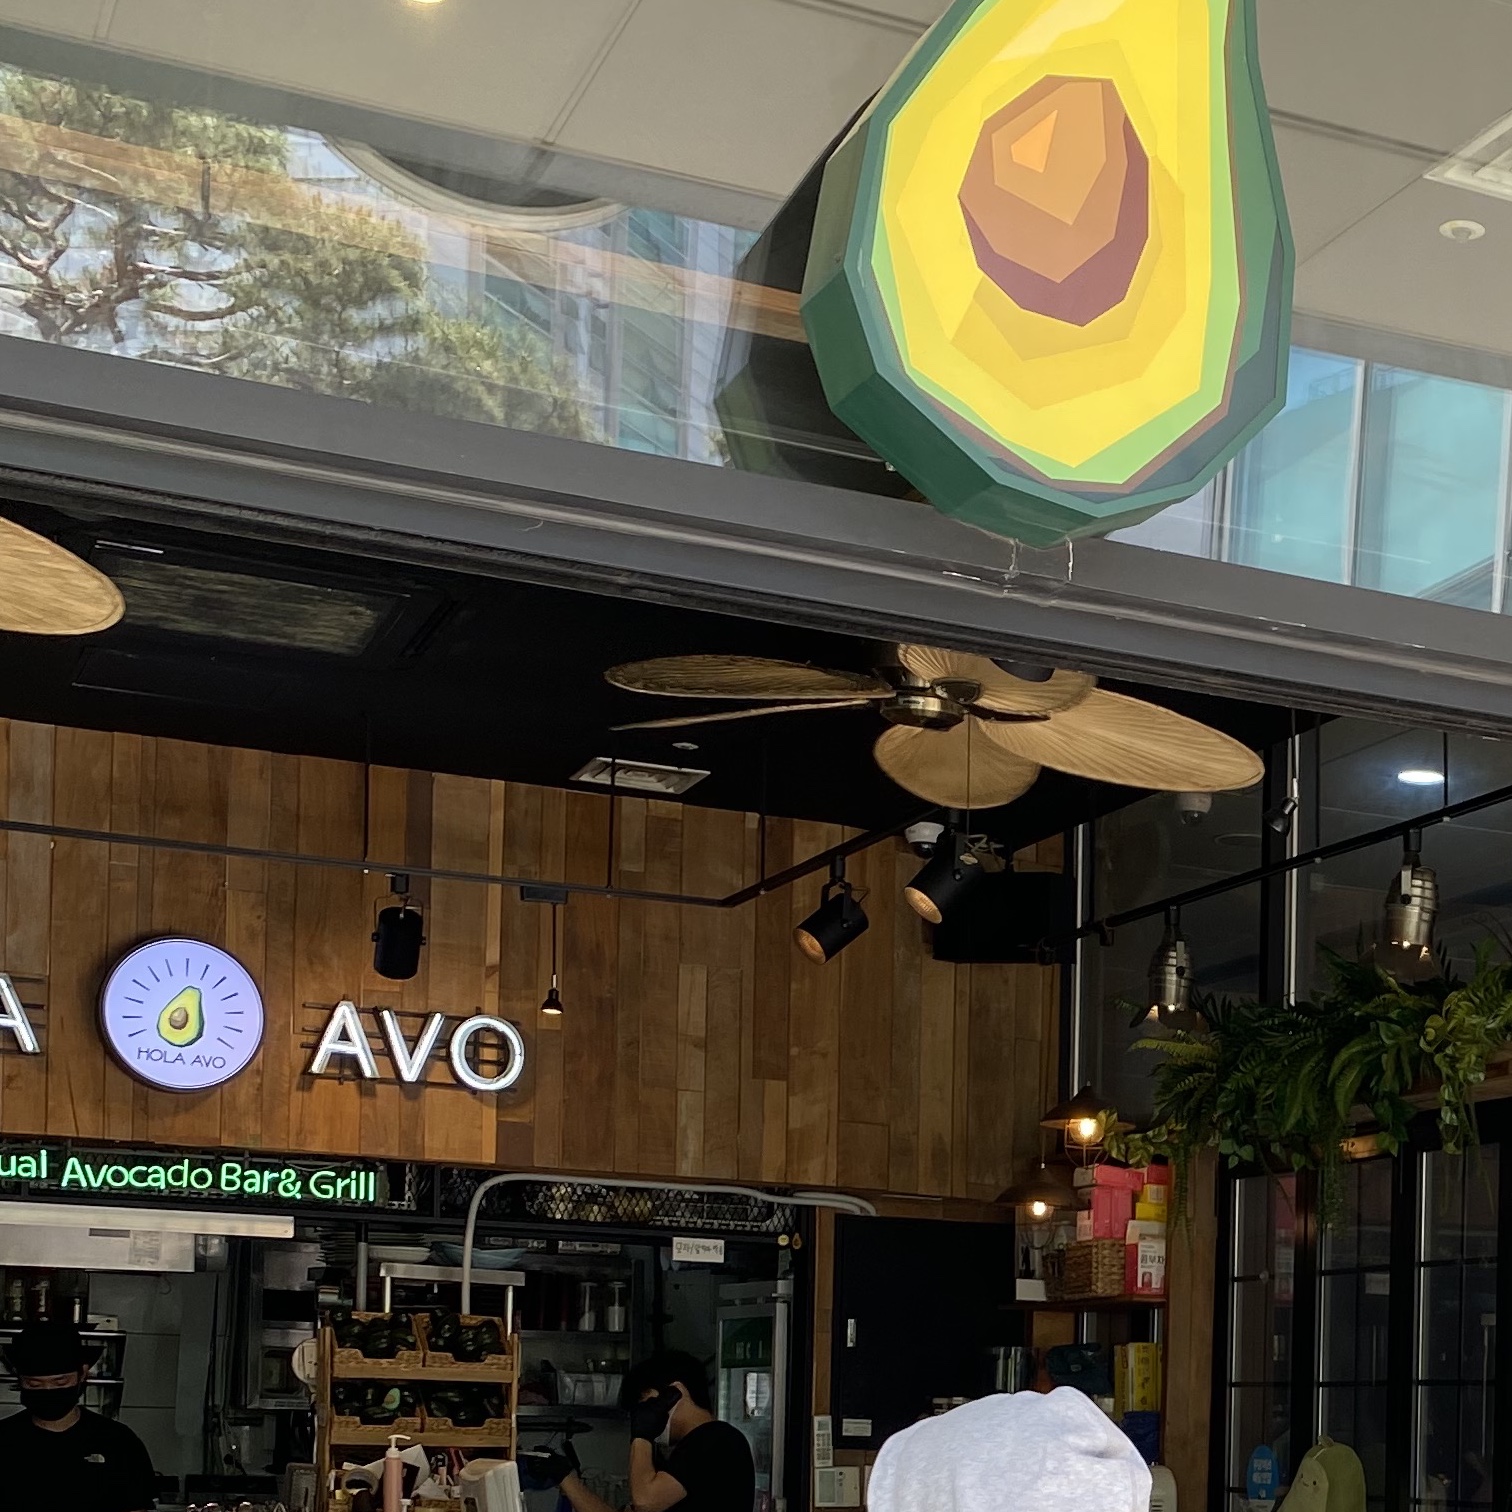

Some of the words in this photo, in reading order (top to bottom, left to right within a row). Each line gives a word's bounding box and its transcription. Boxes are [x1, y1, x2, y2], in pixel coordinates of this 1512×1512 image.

[137, 1047, 185, 1065] HOLA
[190, 1054, 226, 1069] AVO
[308, 1000, 525, 1091] AVO
[60, 1157, 213, 1189] Avocado
[309, 1170, 375, 1202] Grill
